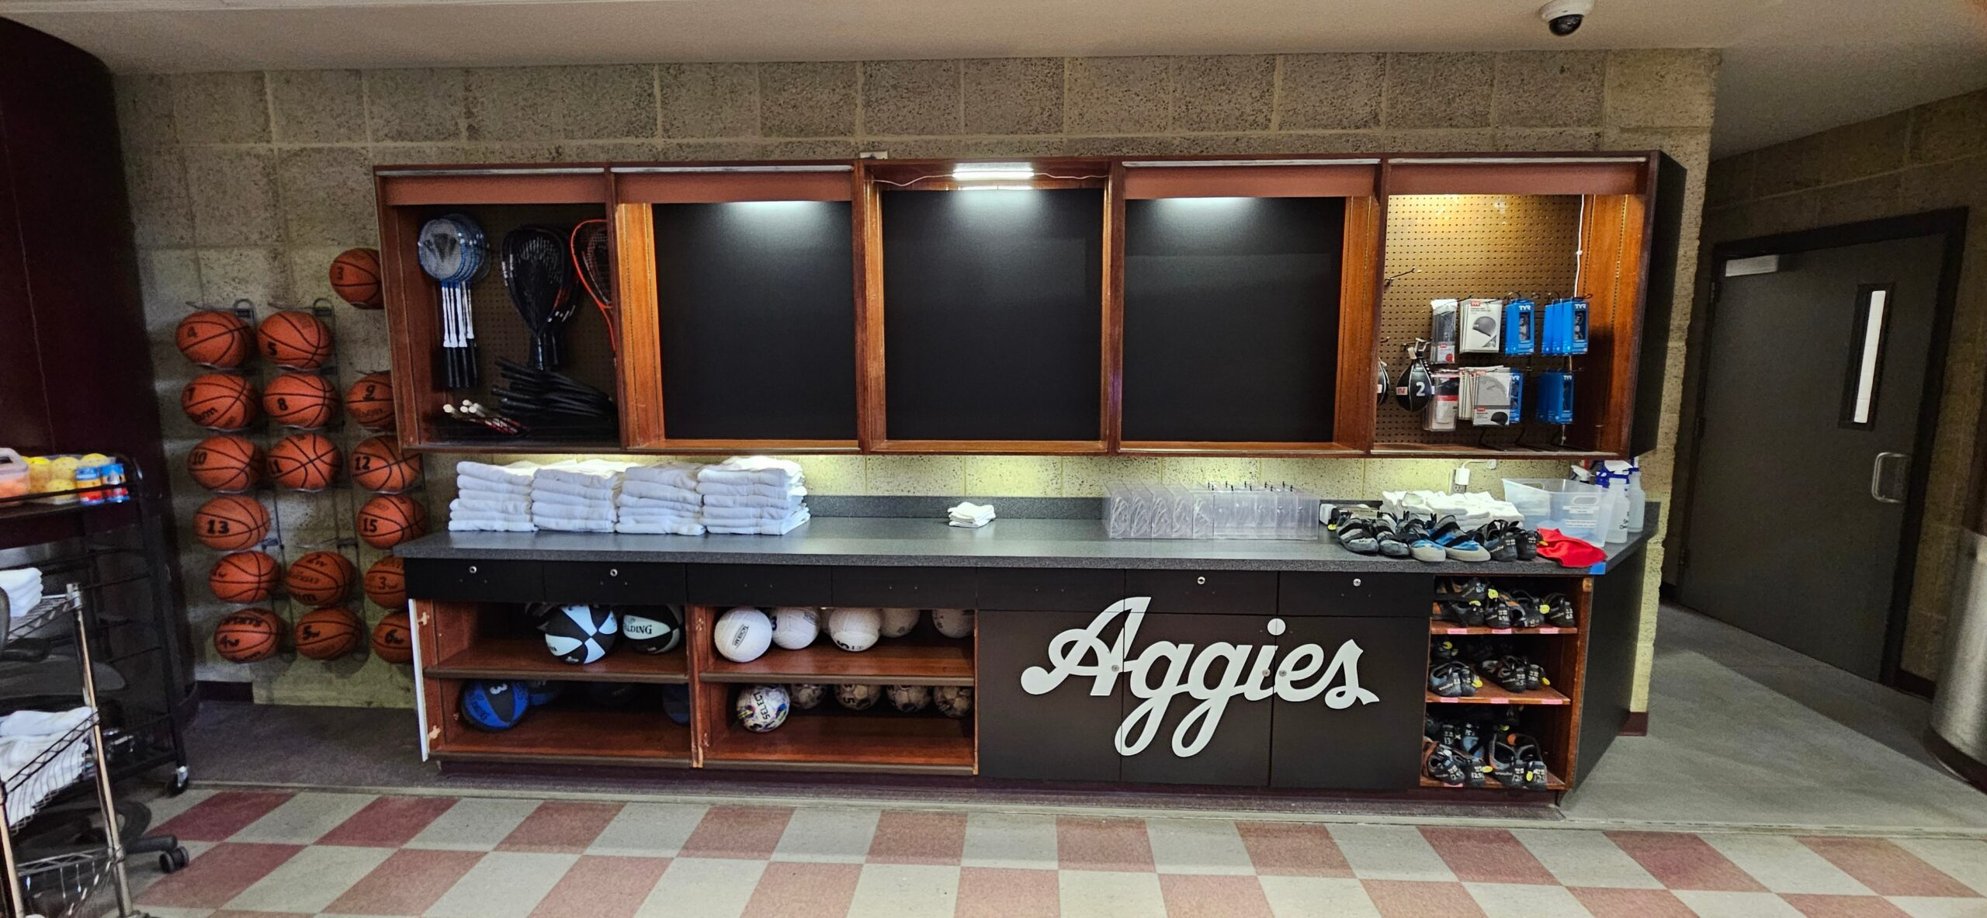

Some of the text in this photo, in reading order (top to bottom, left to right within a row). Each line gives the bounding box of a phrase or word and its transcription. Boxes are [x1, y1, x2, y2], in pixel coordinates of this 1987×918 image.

[268, 341, 277, 355] 5
[1416, 382, 1426, 396] 2
[277, 397, 288, 411] 8
[191, 451, 208, 465] 10
[354, 457, 370, 470] 12
[207, 519, 230, 534] 13
[363, 518, 378, 533] 15
[1021, 596, 1380, 758] Aggies
[753, 691, 770, 720] SELECT
